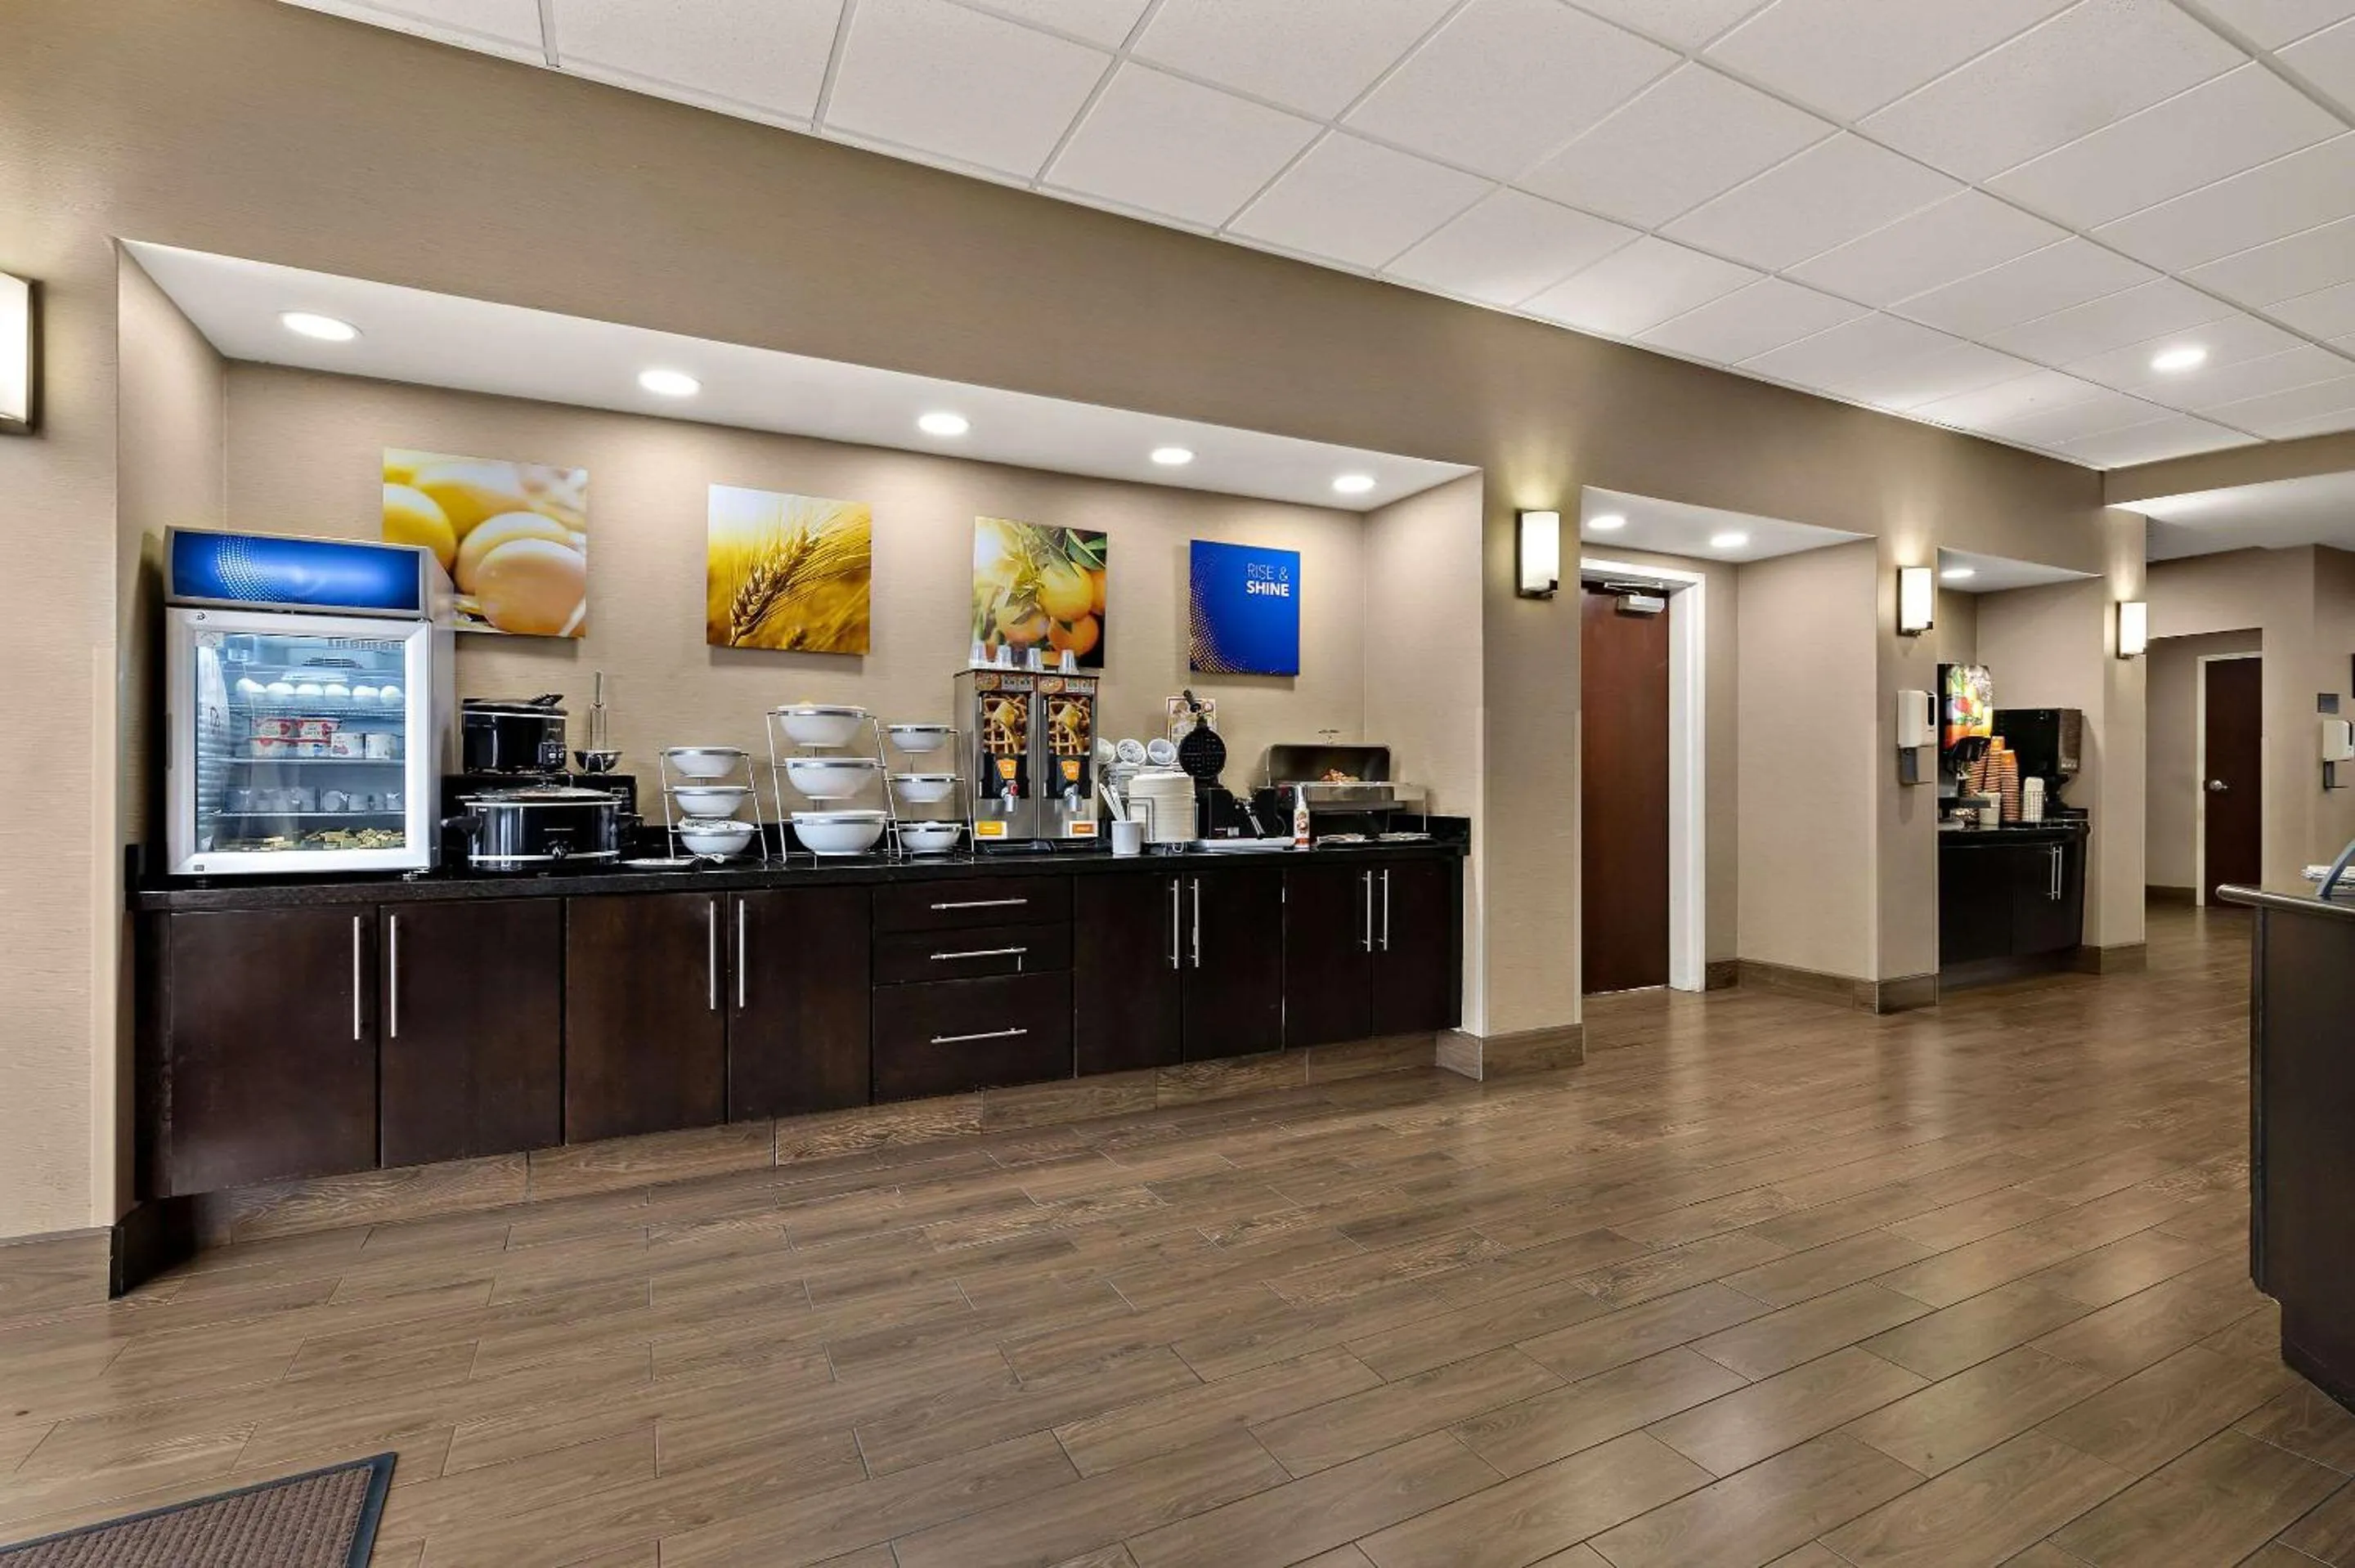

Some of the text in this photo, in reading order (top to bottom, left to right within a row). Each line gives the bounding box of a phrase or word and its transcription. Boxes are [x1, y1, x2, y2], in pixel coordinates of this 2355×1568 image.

[1247, 562, 1289, 581] RISE &
[1246, 580, 1290, 598] SHINE
